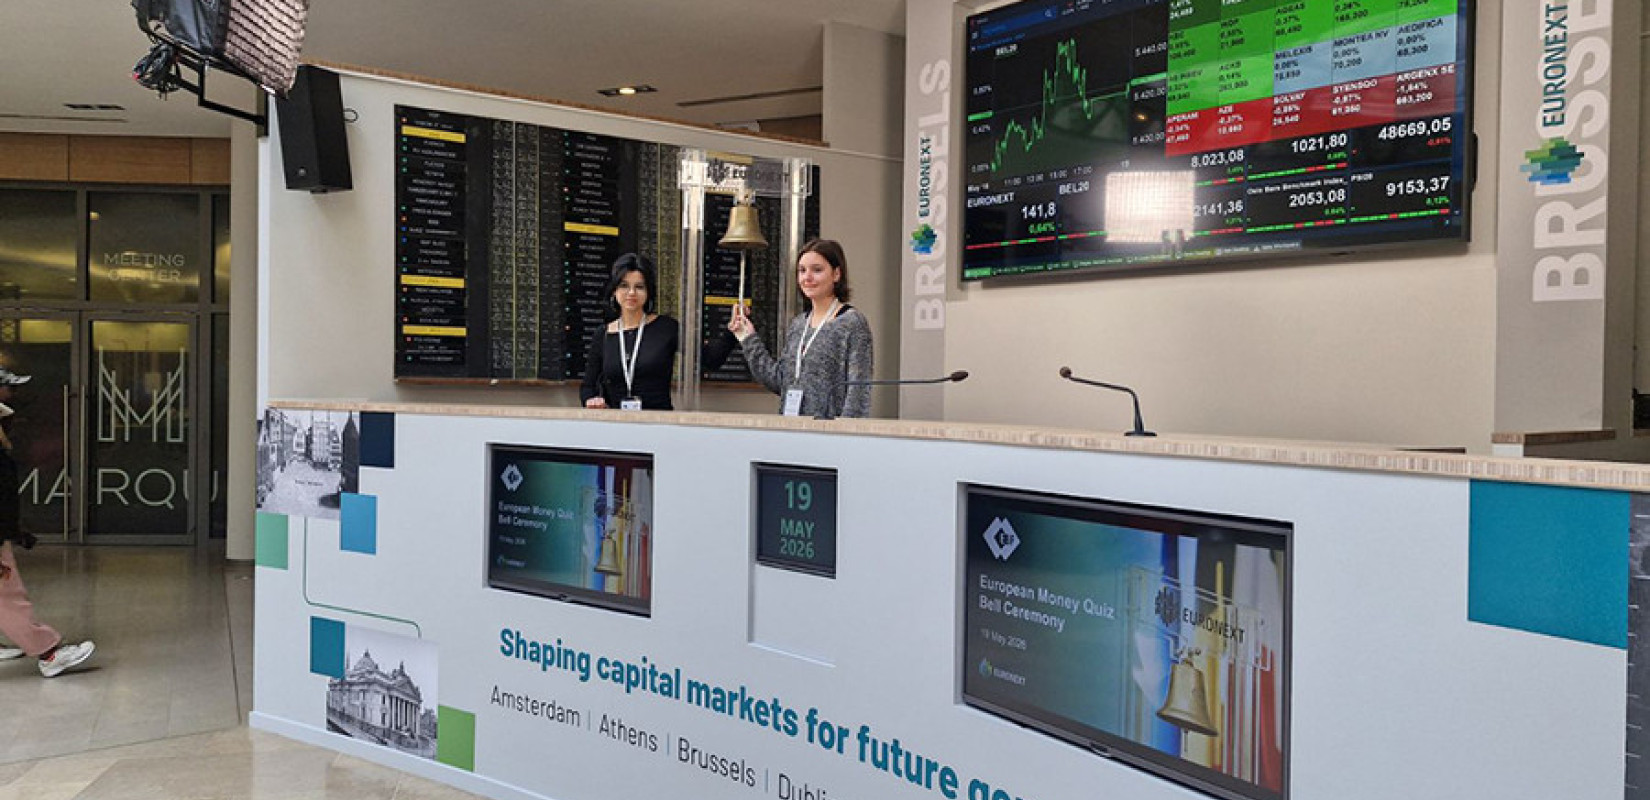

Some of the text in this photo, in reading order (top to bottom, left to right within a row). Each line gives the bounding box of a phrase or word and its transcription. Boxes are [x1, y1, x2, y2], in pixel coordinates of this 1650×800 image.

[1542, 3, 1569, 128] EURONEXT
[1377, 117, 1452, 141] 48669,05
[1291, 134, 1348, 153] 1021,80
[1190, 149, 1245, 169] 8.023,08
[918, 137, 932, 218] EURONEXT
[1058, 181, 1090, 195] BEL20
[1385, 176, 1450, 197] 9153,37
[967, 191, 1015, 208] EURONEXT
[1288, 188, 1346, 208] 2053,08
[1021, 201, 1056, 220] 141,8
[104, 252, 185, 267] MEETING
[784, 480, 812, 511] 19
[780, 518, 815, 539] MAY
[780, 538, 815, 559] 2026
[979, 574, 1117, 620] European Money Quiz
[979, 595, 1067, 633] Bell Ceremony
[499, 628, 591, 682] Shaping
[596, 655, 682, 700] capital
[686, 677, 800, 738] markets
[805, 707, 850, 755] for
[856, 724, 959, 800] future
[490, 685, 581, 728] Amsterdam
[599, 714, 659, 752] Athens
[677, 737, 757, 788] Brussels
